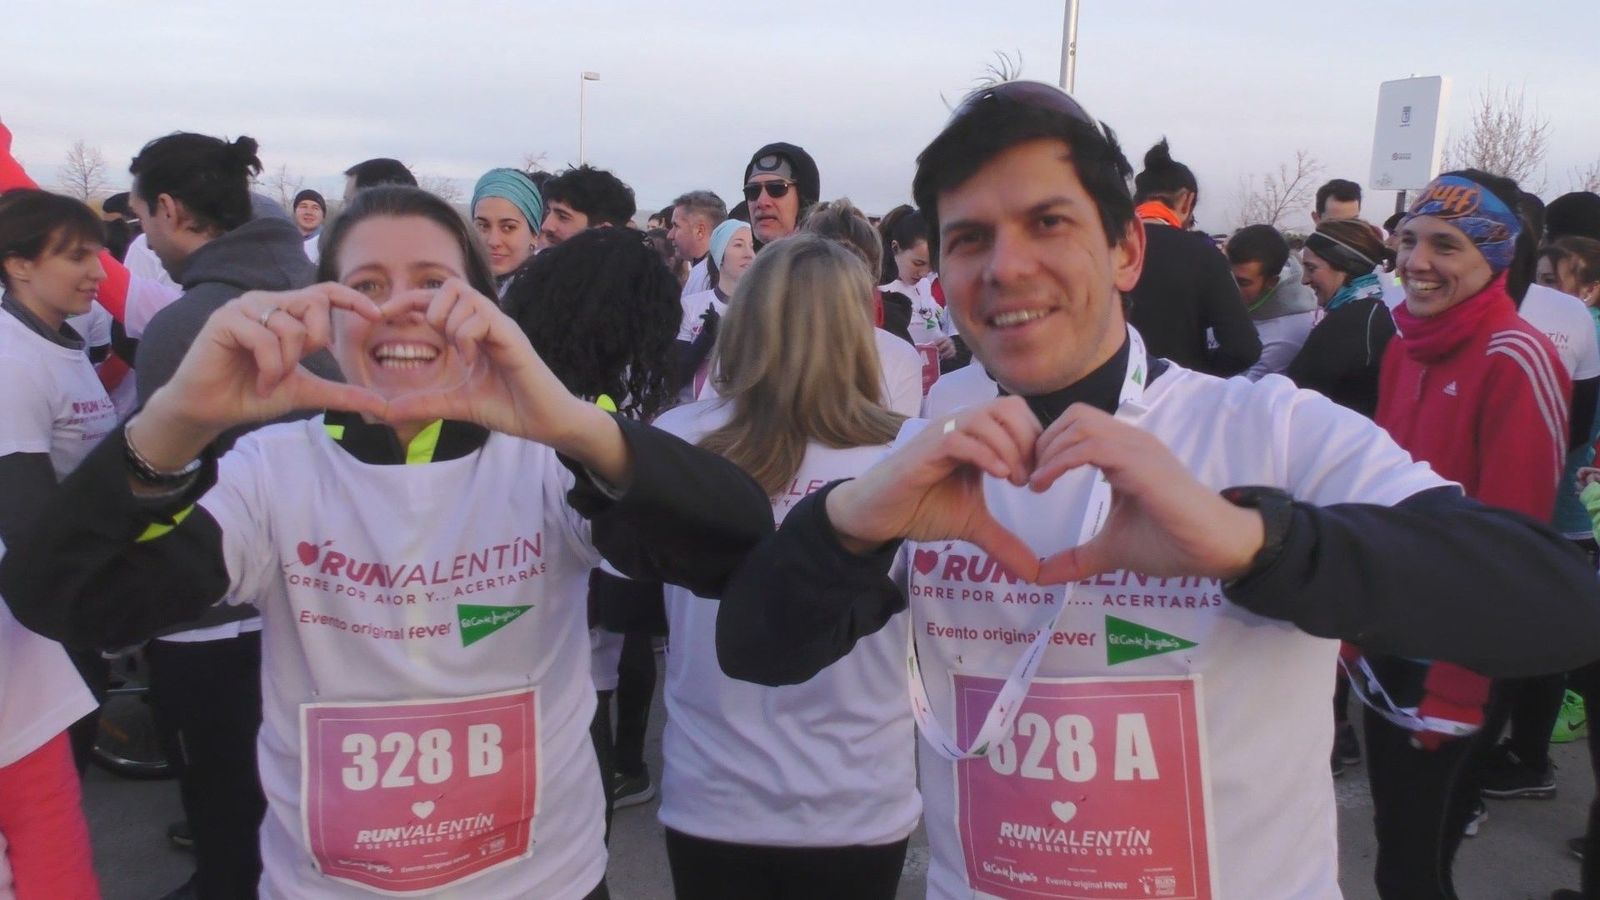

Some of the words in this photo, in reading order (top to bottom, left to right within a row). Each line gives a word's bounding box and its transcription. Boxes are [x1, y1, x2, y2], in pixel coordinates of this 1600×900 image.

[335, 583, 366, 601] POR
[454, 562, 547, 597] ACERTARÁS
[962, 589, 994, 602] POR
[1003, 592, 1055, 605] AMOR
[1102, 590, 1222, 609] ACERTARÁS
[300, 610, 347, 631] Evento
[351, 622, 404, 640] original
[409, 622, 453, 639] fever
[926, 622, 978, 640] Evento
[1048, 631, 1097, 646] ever
[342, 728, 453, 791] 328
[467, 723, 504, 778] B
[1114, 713, 1160, 781] A
[357, 813, 495, 844] RUNVALENTÍN
[1000, 821, 1152, 847] RUNVALENTÍN
[1009, 840, 1023, 848] DE
[1030, 843, 1089, 855] FEBRERO
[1096, 848, 1113, 857] DE
